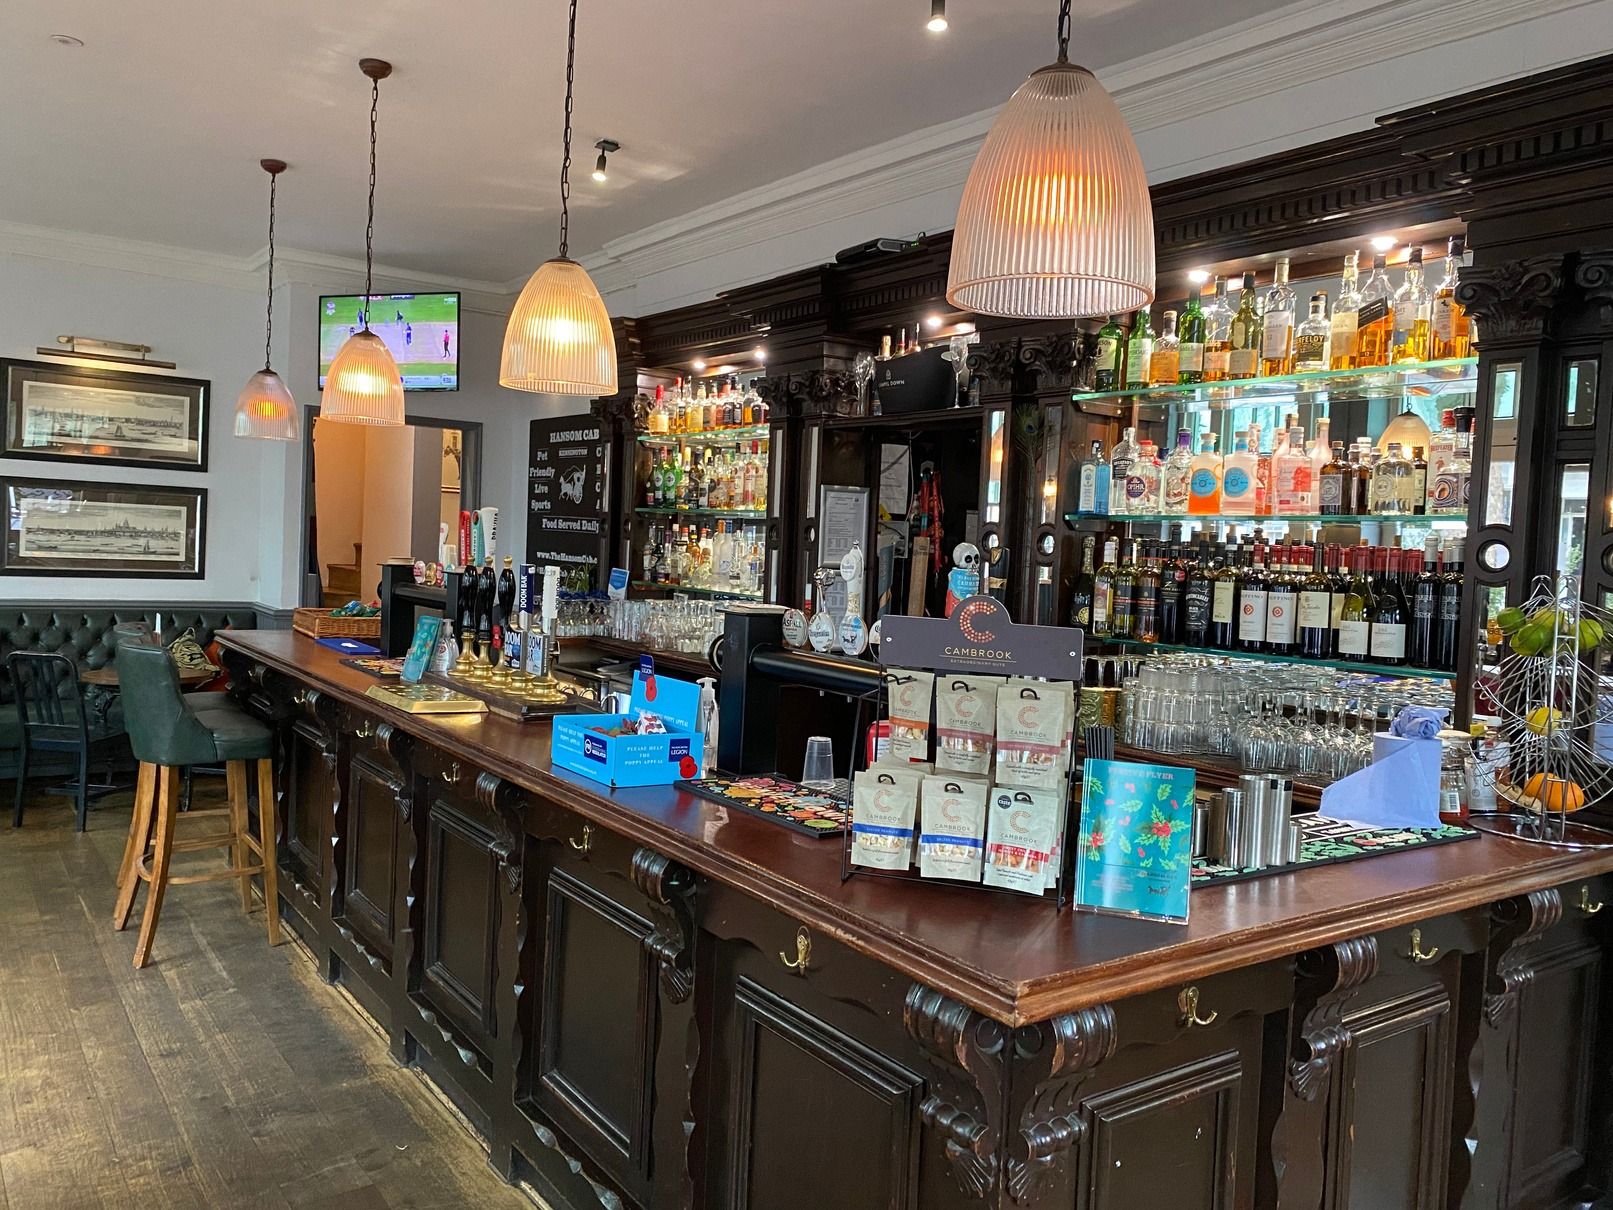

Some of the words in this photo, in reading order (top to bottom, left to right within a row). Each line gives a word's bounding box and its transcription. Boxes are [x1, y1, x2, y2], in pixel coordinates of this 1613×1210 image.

[550, 430, 583, 443] HANSOM
[583, 428, 600, 441] CAB
[537, 450, 548, 461] Pet
[529, 466, 556, 479] Friendly
[534, 483, 548, 493] Live
[530, 500, 551, 511] Sports
[542, 518, 557, 529] Food
[557, 519, 581, 530] Served
[581, 520, 600, 533] Daily
[520, 588, 528, 608] DOOM
[944, 646, 1012, 659] CAMBROOK
[1145, 770, 1174, 780] FLYER
[934, 823, 971, 832] CAMBROOK
